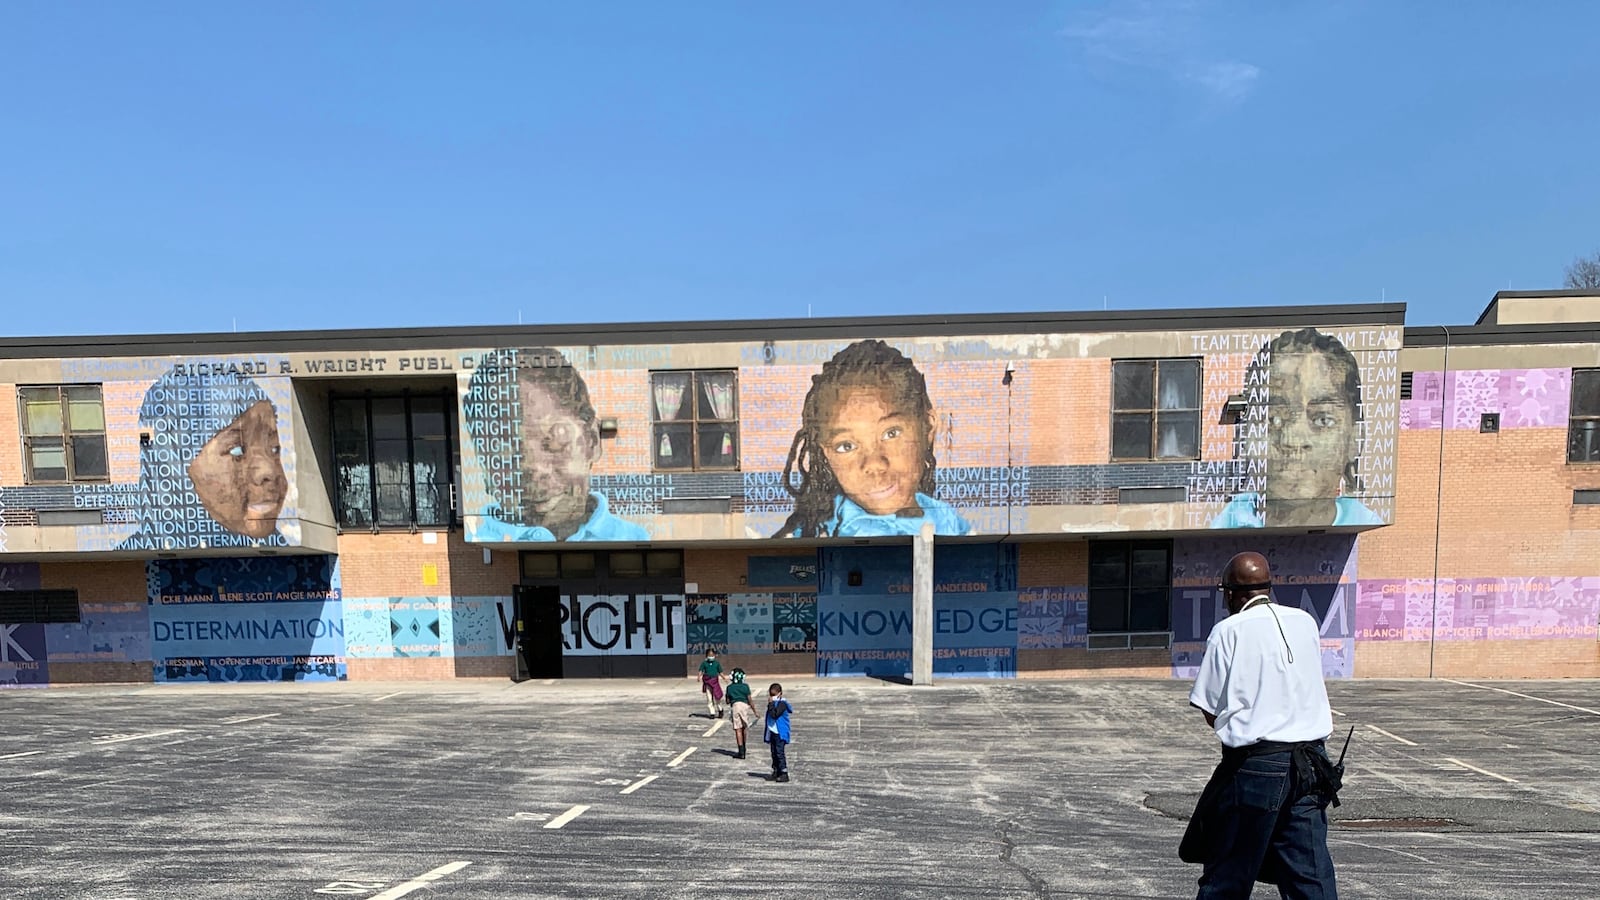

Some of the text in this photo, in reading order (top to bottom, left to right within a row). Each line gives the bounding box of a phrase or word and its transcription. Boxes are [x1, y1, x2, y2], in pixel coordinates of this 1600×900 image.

[1191, 333, 1271, 351] TEAM TEAM
[1232, 351, 1271, 367] TEAM
[1360, 350, 1397, 364] TEAM
[174, 360, 267, 376] RICHARD
[280, 360, 298, 373] R.
[305, 357, 386, 374] WRIGHT
[1358, 366, 1397, 383] TEAM
[1231, 369, 1270, 386] TEAM
[1356, 384, 1396, 401] TEAM
[462, 402, 521, 418] WRIGHT
[1356, 402, 1395, 419] TEAM
[462, 419, 522, 436] WRIGHT
[1232, 422, 1268, 439] TEAM
[1355, 420, 1394, 436] TEAM
[463, 437, 522, 453] WRIGHT
[1231, 440, 1268, 457] TEAM
[1355, 438, 1394, 454] TEAM
[464, 454, 523, 470] WRIGHT
[1189, 458, 1267, 474] TEAM TEAM
[1354, 455, 1393, 472] TEAM
[464, 471, 523, 487] WRIGHT
[935, 466, 1031, 482] KNOWLEDGE
[1353, 473, 1392, 489] TEAM
[935, 482, 1031, 499] KNOWLEDGE
[1187, 475, 1267, 492] TEAM TEAM
[74, 493, 184, 508] DETERMINATION
[614, 487, 676, 502] WRIGHT
[1189, 493, 1226, 509] TEAM
[1353, 490, 1391, 507] TEAM
[934, 582, 987, 593] ANDERSON
[184, 594, 213, 603] MANN
[245, 592, 273, 601] SCOTT
[276, 591, 304, 600] ANGIE
[307, 591, 339, 600] MATHIS
[154, 617, 344, 641] DETERMINATION
[819, 607, 1018, 636] KNOWEDGE
[780, 641, 817, 650] TUCKER
[210, 657, 251, 666] FLORENCE
[252, 656, 288, 666] MITCHELL
[817, 651, 853, 660] MARTIN
[855, 650, 909, 660] KESSELMAN
